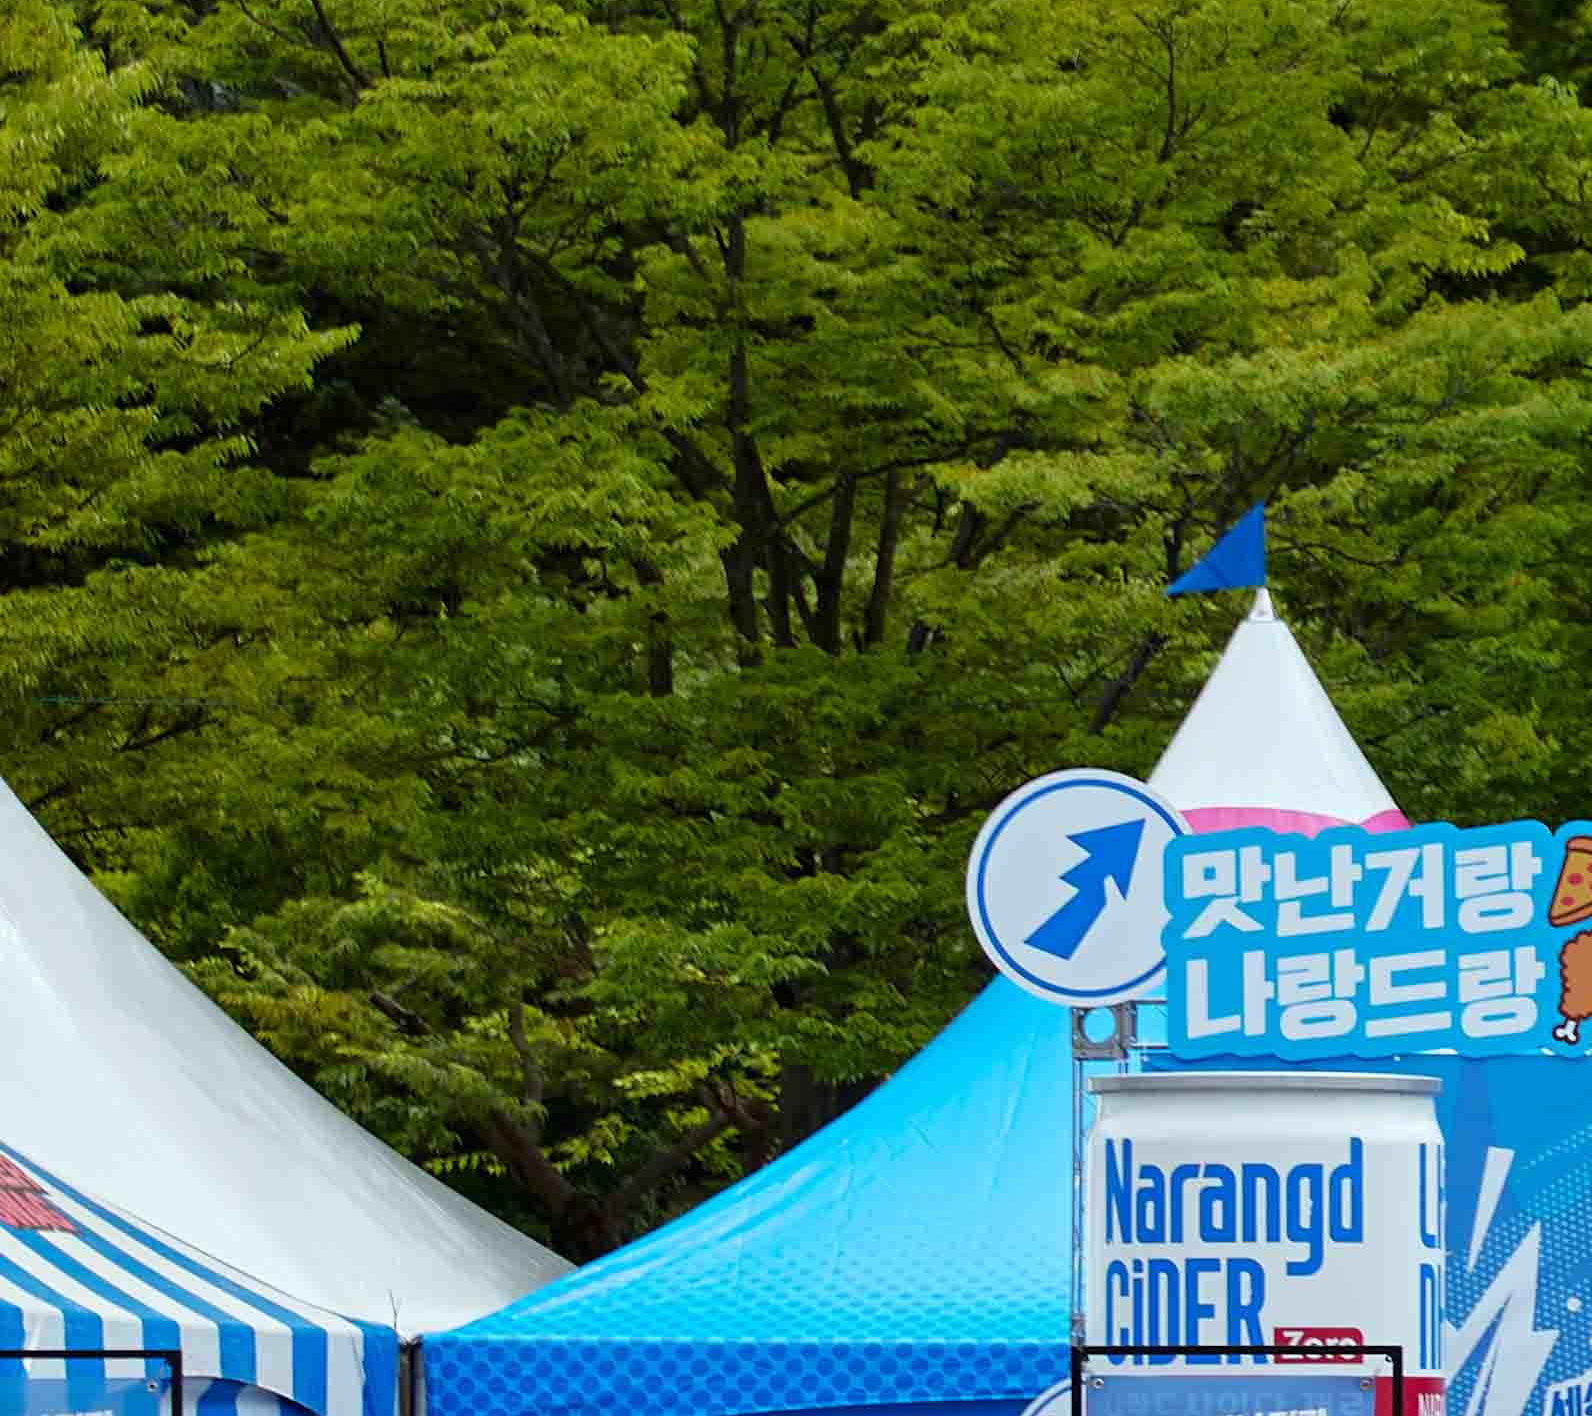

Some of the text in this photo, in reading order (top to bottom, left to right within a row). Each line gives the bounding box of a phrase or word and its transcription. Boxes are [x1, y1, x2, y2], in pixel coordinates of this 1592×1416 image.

[1185, 934, 1545, 1043] 나랑드랑
[1104, 1137, 1364, 1277] Narangd
[1283, 1331, 1357, 1362] Zero
